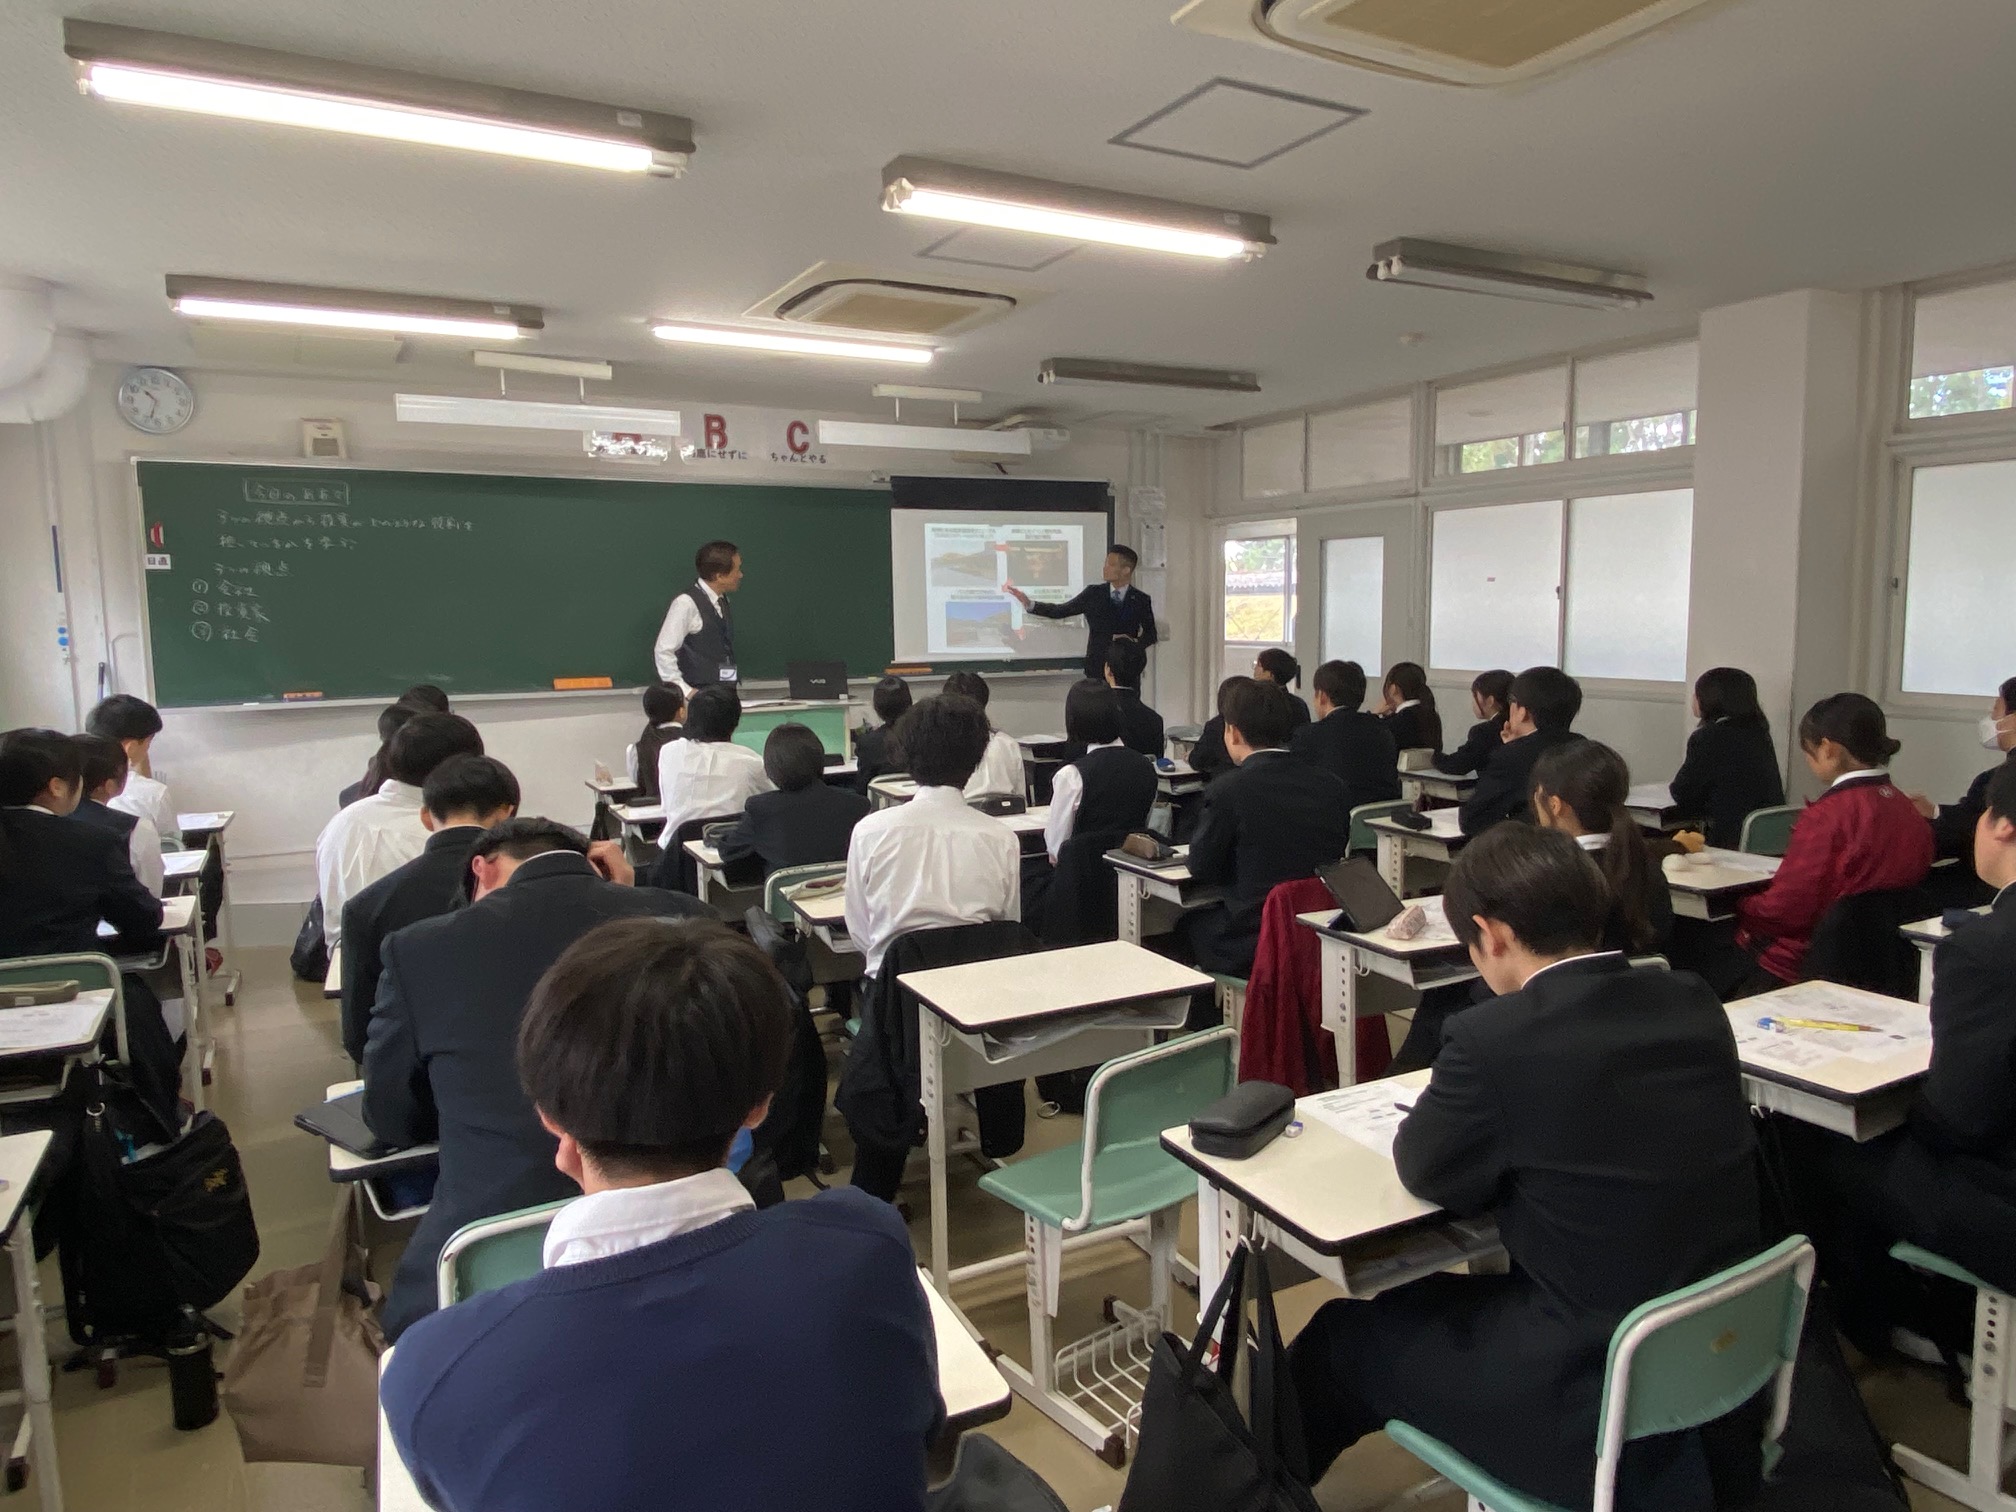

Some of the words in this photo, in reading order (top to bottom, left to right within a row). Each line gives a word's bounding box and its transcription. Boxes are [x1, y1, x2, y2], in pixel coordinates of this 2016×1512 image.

[703, 413, 728, 449] B
[786, 420, 810, 454] C
[771, 452, 827, 464] ちゃんとやる
